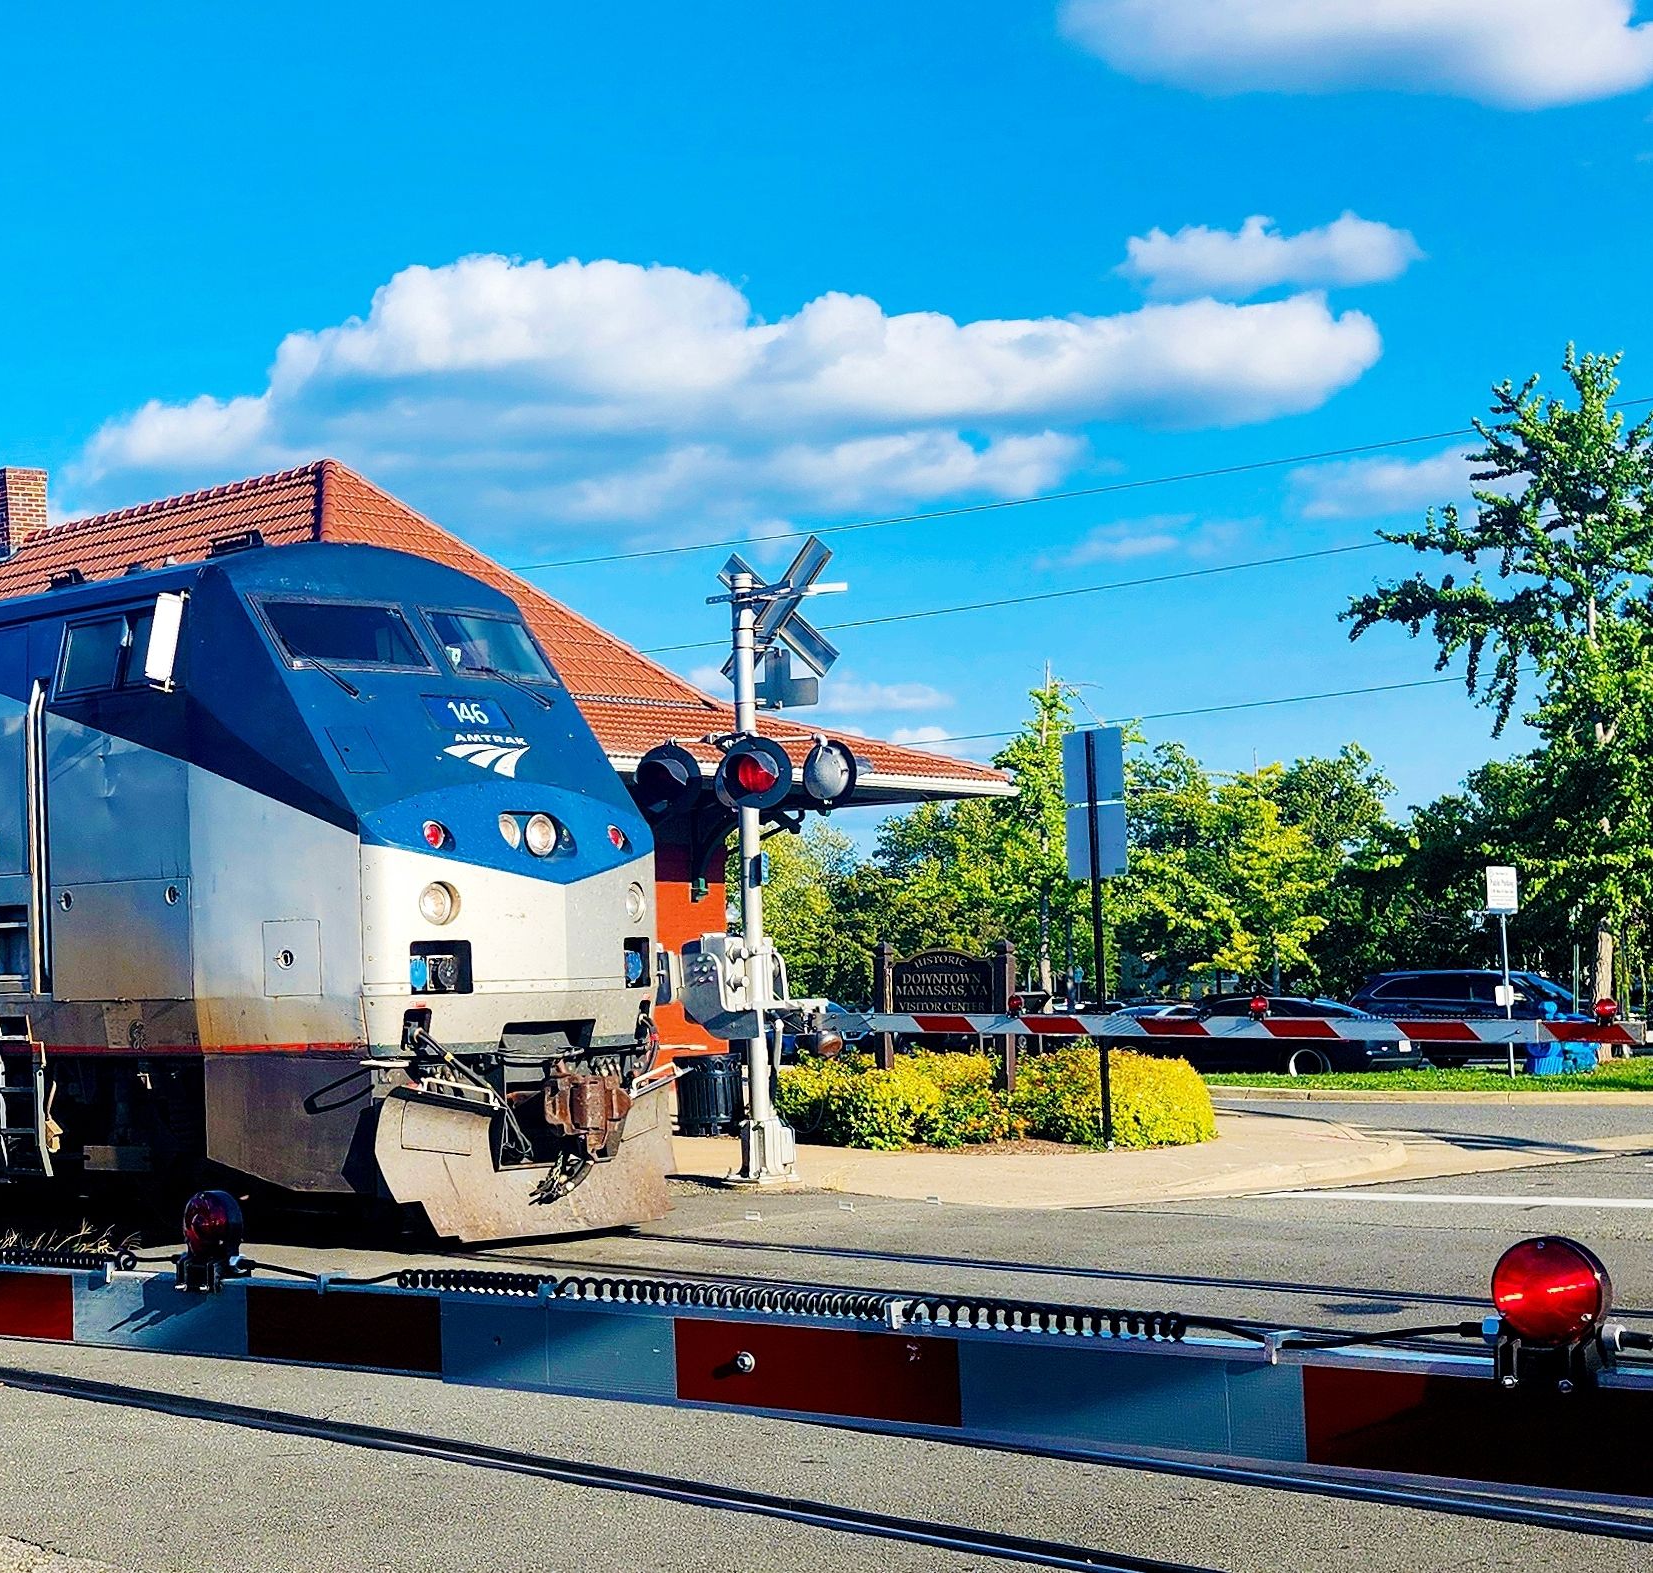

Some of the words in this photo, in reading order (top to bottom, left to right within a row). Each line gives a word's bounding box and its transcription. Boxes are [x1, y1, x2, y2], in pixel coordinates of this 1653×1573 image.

[447, 702, 489, 724] 146
[455, 733, 528, 745] AMTRAK
[914, 954, 968, 968] HISTORIC
[902, 973, 981, 984] DOWNTOWN
[896, 985, 966, 997] MANASSAS,
[970, 986, 988, 995] VA
[899, 1002, 942, 1012] VISITOR
[944, 1002, 985, 1012] CENTER
